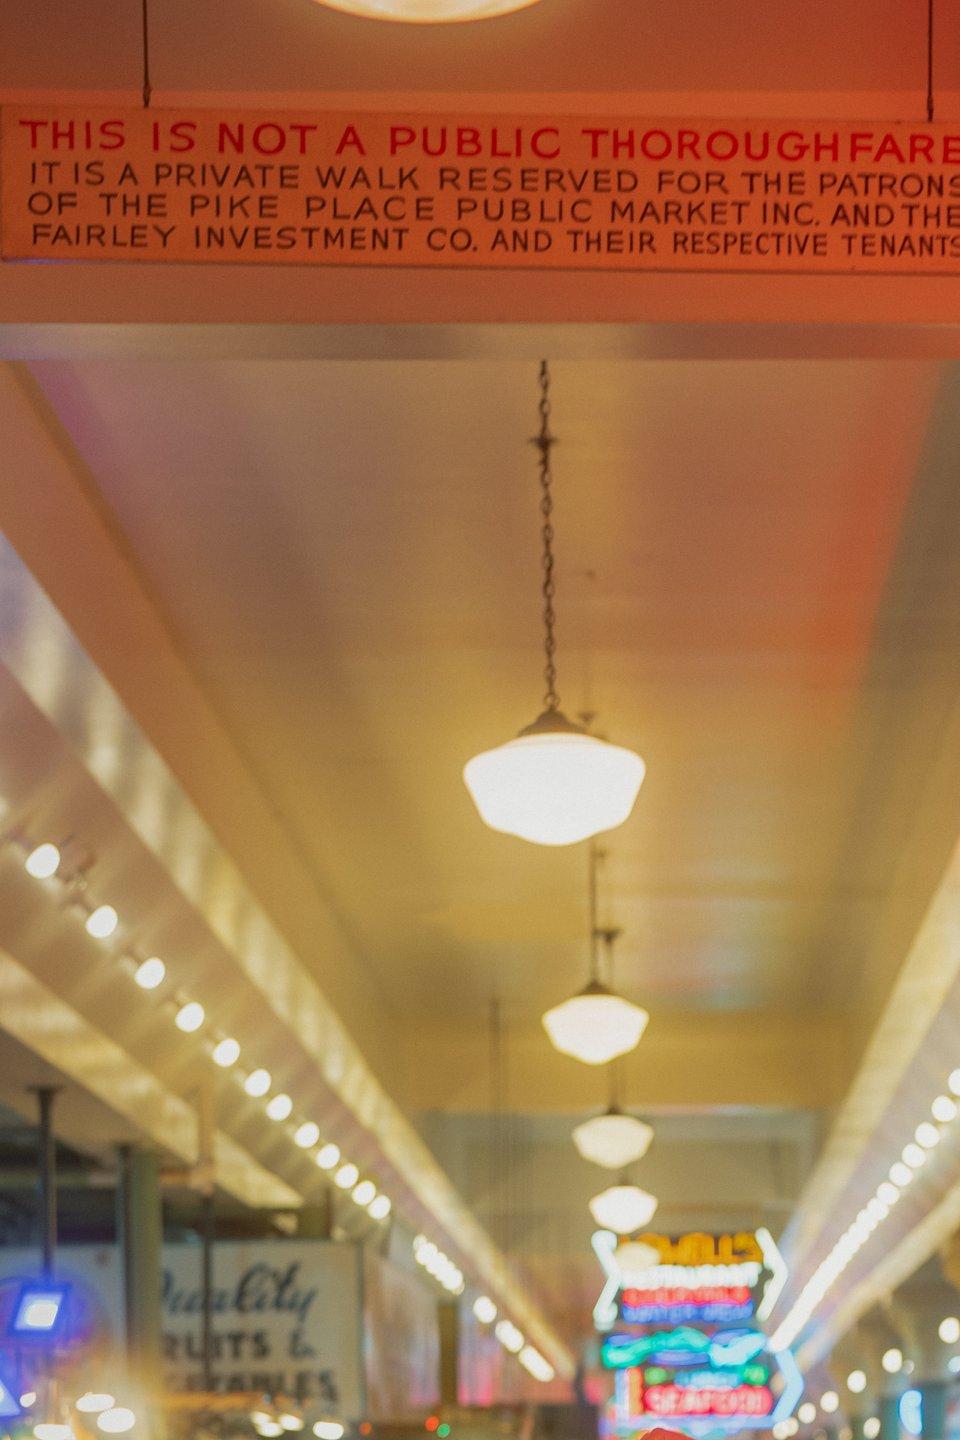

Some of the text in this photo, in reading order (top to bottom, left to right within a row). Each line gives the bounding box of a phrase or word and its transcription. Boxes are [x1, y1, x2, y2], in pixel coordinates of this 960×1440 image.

[19, 119, 125, 151] THIS
[153, 120, 197, 153] IS
[217, 122, 318, 156] NOT
[335, 124, 367, 156] A
[390, 126, 560, 160] PUBLIC
[31, 161, 61, 185] IT
[74, 160, 105, 186] IS
[118, 161, 139, 186] A
[155, 162, 299, 189] PRIVATE
[315, 165, 419, 191] WALK
[439, 166, 638, 194] RESERVED
[658, 169, 730, 195] FOR
[740, 171, 806, 196] THE
[27, 190, 77, 216] OF
[99, 192, 167, 218] THE
[190, 194, 278, 218] PIKE
[305, 195, 434, 222] PLACE
[457, 197, 592, 224] PUBLIC
[611, 199, 750, 225] MARKET
[762, 200, 820, 227] INC.
[830, 203, 894, 228] AND
[32, 223, 176, 248] FAIRLEY
[195, 225, 409, 251] INVESTMENT
[426, 227, 478, 252] CO.
[490, 228, 552, 253] AND
[566, 229, 656, 254] THEIR
[673, 231, 827, 257] RESPECTIVE
[162, 1331, 269, 1360] RUITS
